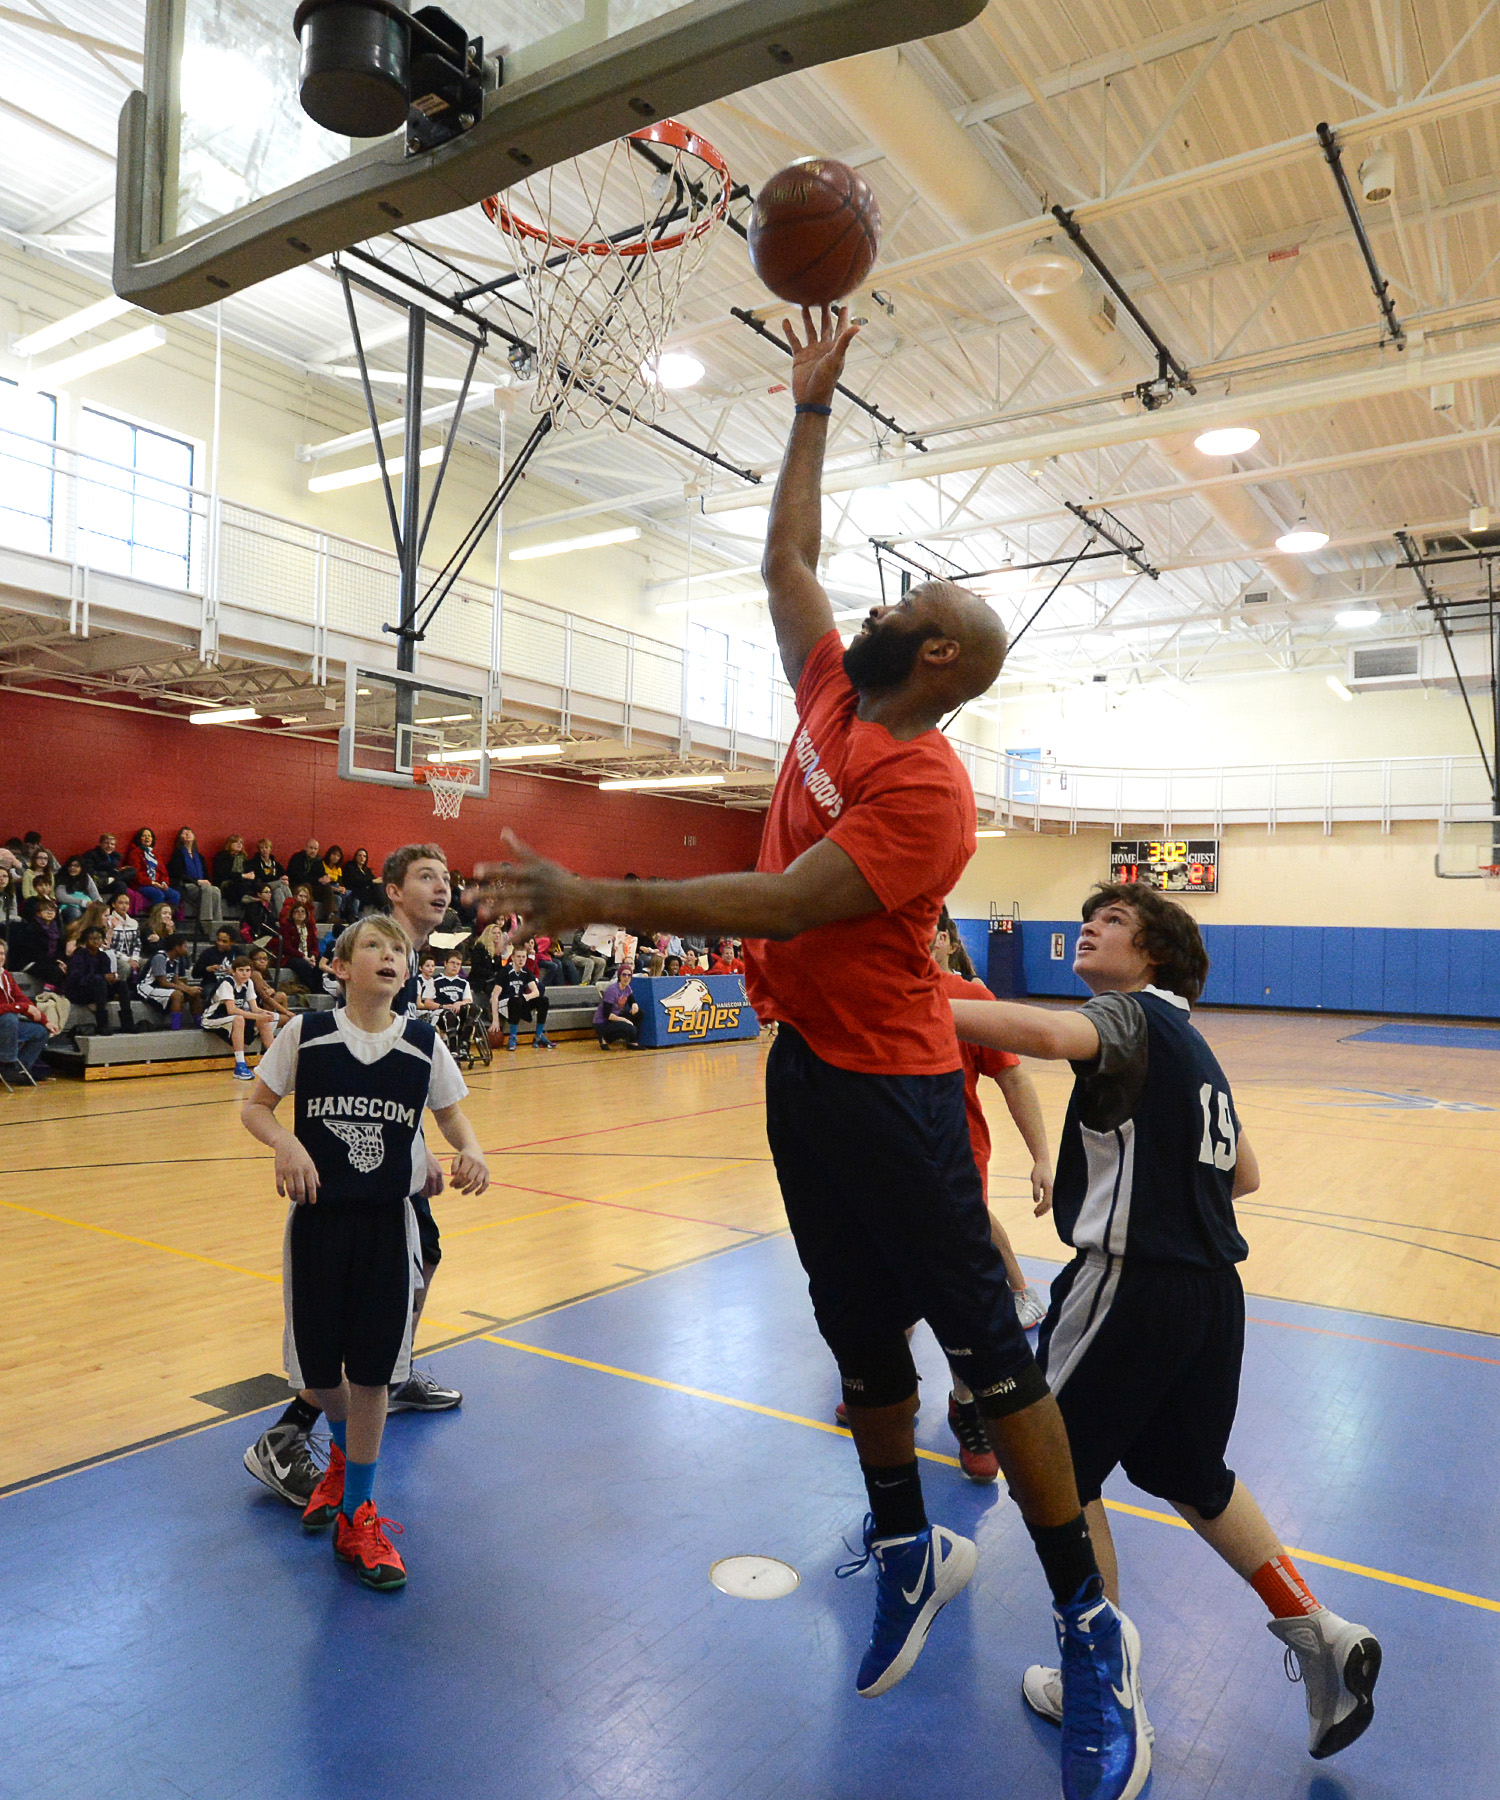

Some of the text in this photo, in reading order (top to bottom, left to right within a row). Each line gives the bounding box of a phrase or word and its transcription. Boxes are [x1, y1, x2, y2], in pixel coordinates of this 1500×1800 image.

[806, 768, 844, 818] HOOPS
[1111, 853, 1137, 864] HOME
[1188, 853, 1215, 864] GUEST
[1120, 864, 1137, 884] 11
[1189, 863, 1215, 884] 21
[667, 1005, 740, 1038] Eagles
[306, 1096, 415, 1128] HANSCOM
[1199, 1083, 1236, 1171] 19
